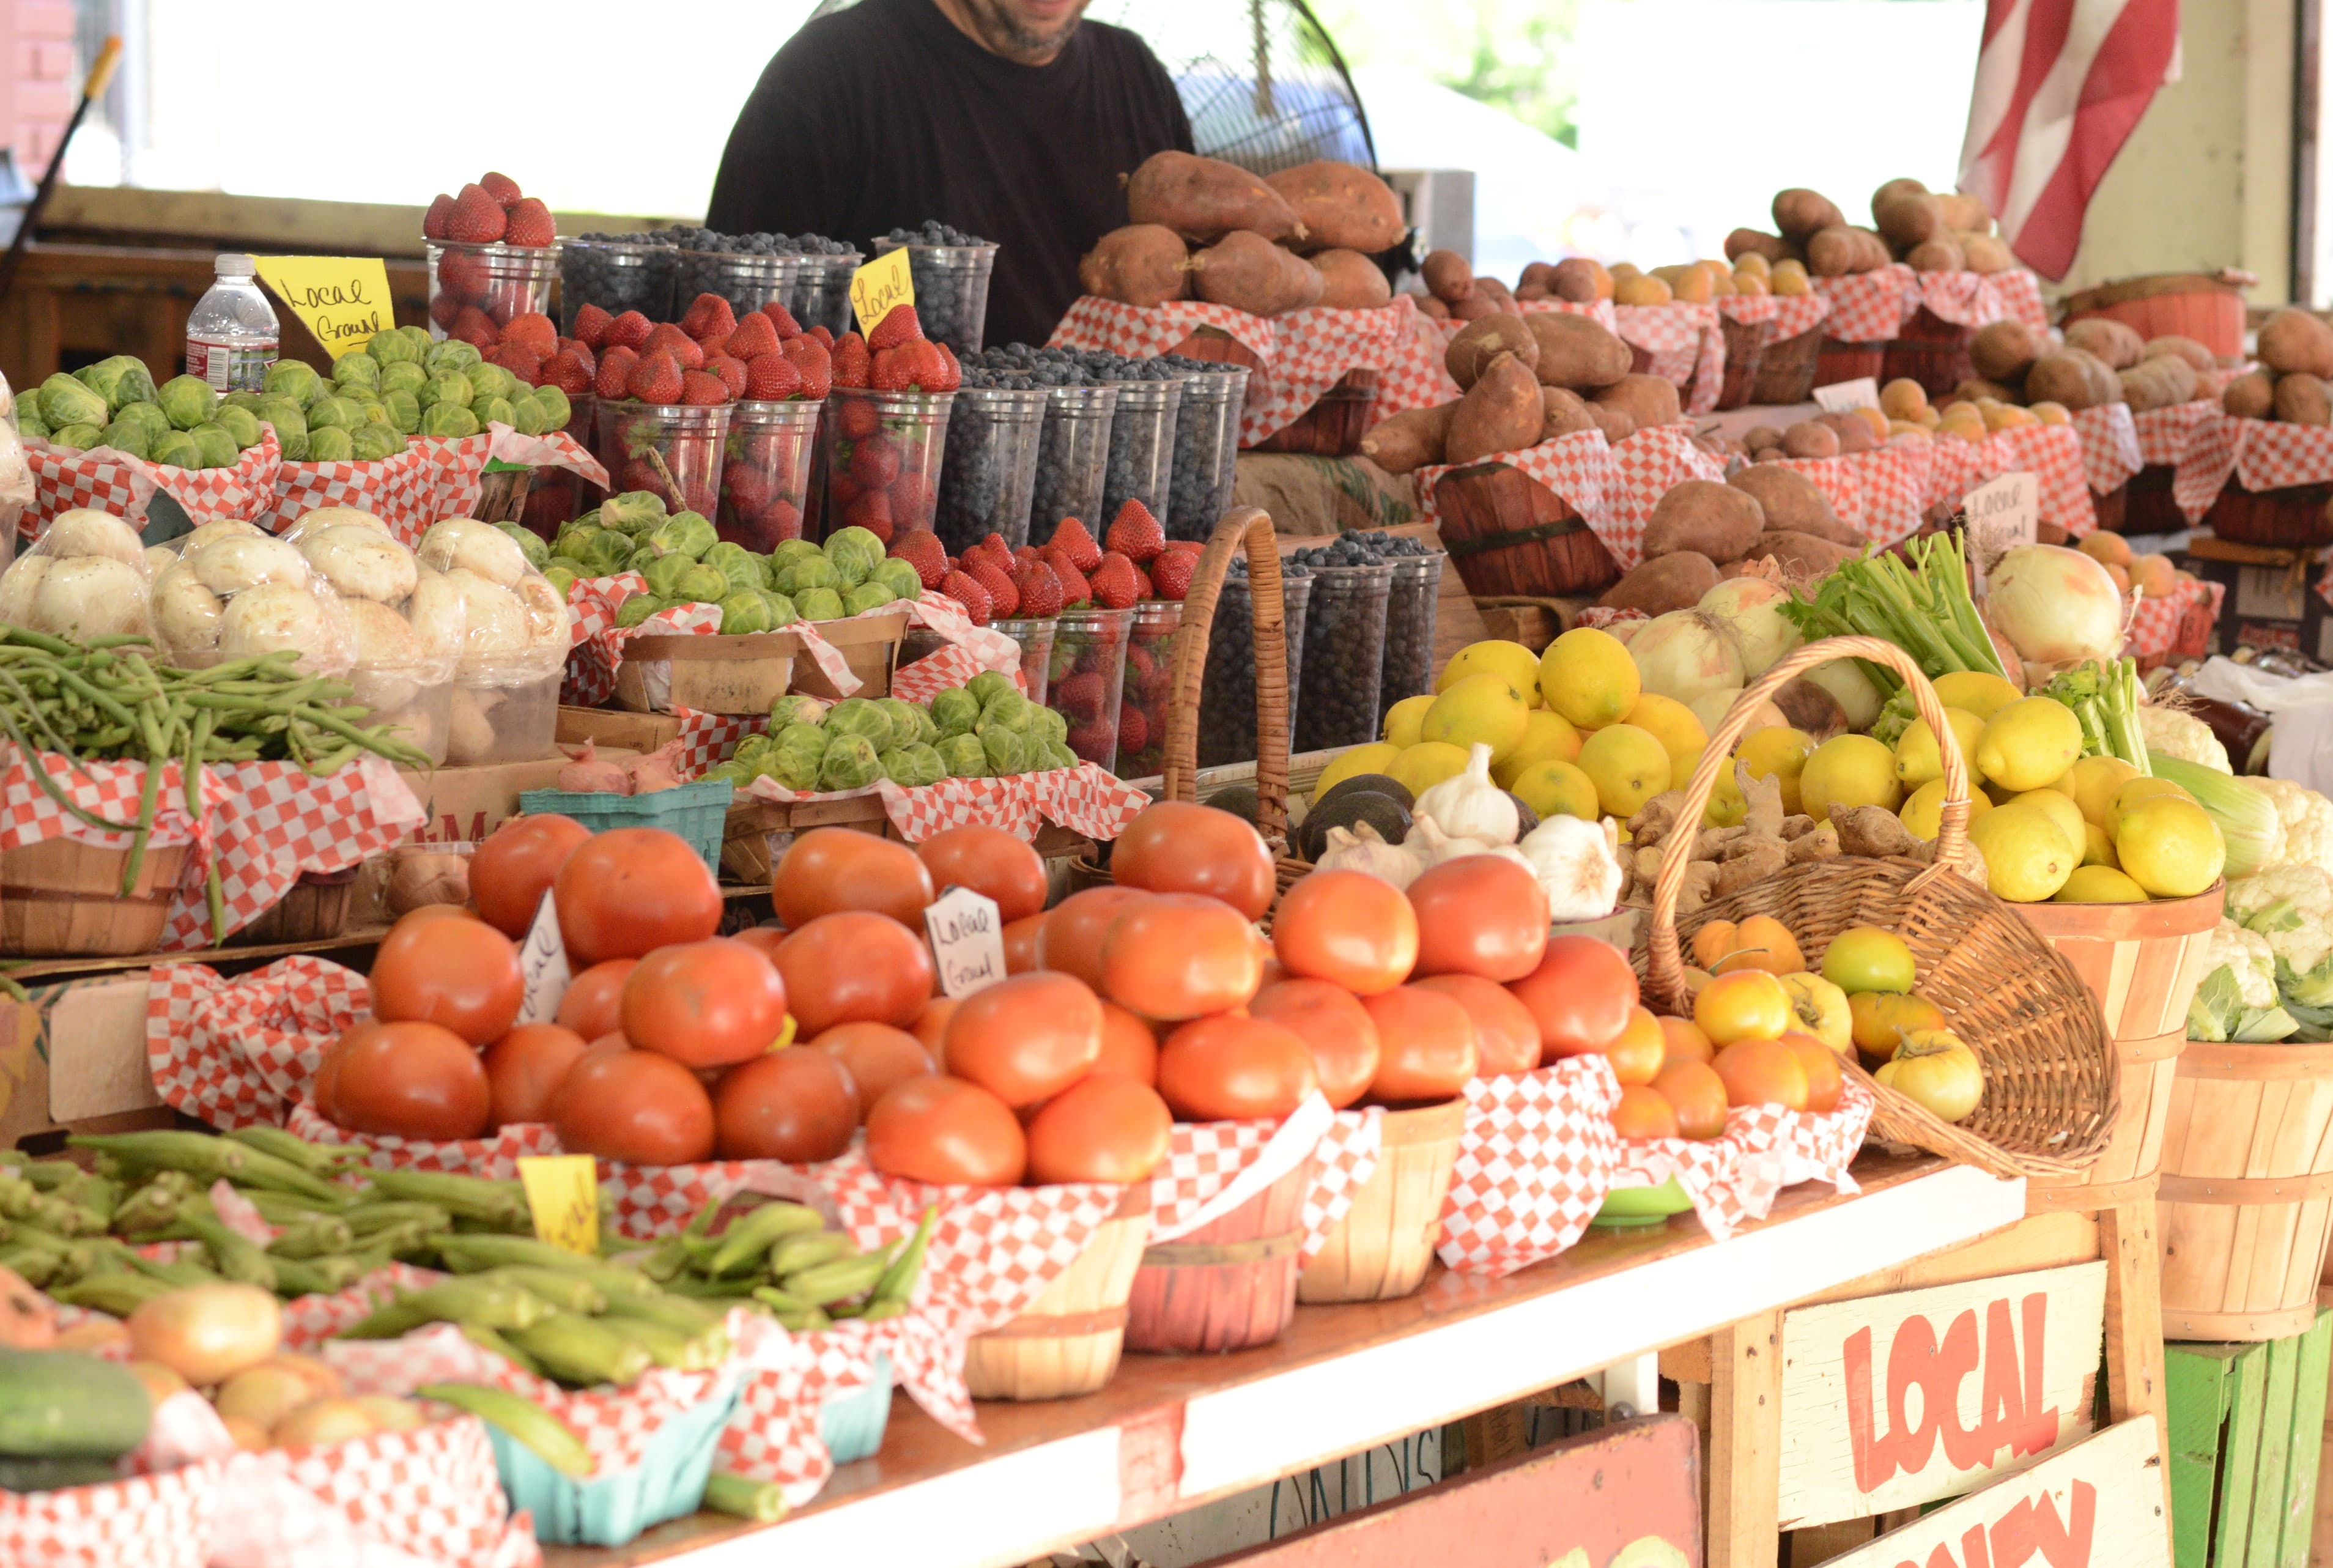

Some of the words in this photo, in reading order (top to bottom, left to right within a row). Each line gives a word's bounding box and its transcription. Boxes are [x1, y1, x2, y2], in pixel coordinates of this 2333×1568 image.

[279, 279, 372, 308] Local
[853, 264, 909, 325] Local
[933, 907, 992, 945] Local
[517, 924, 560, 1019] ocal
[1843, 1292, 2059, 1493] LOCAL
